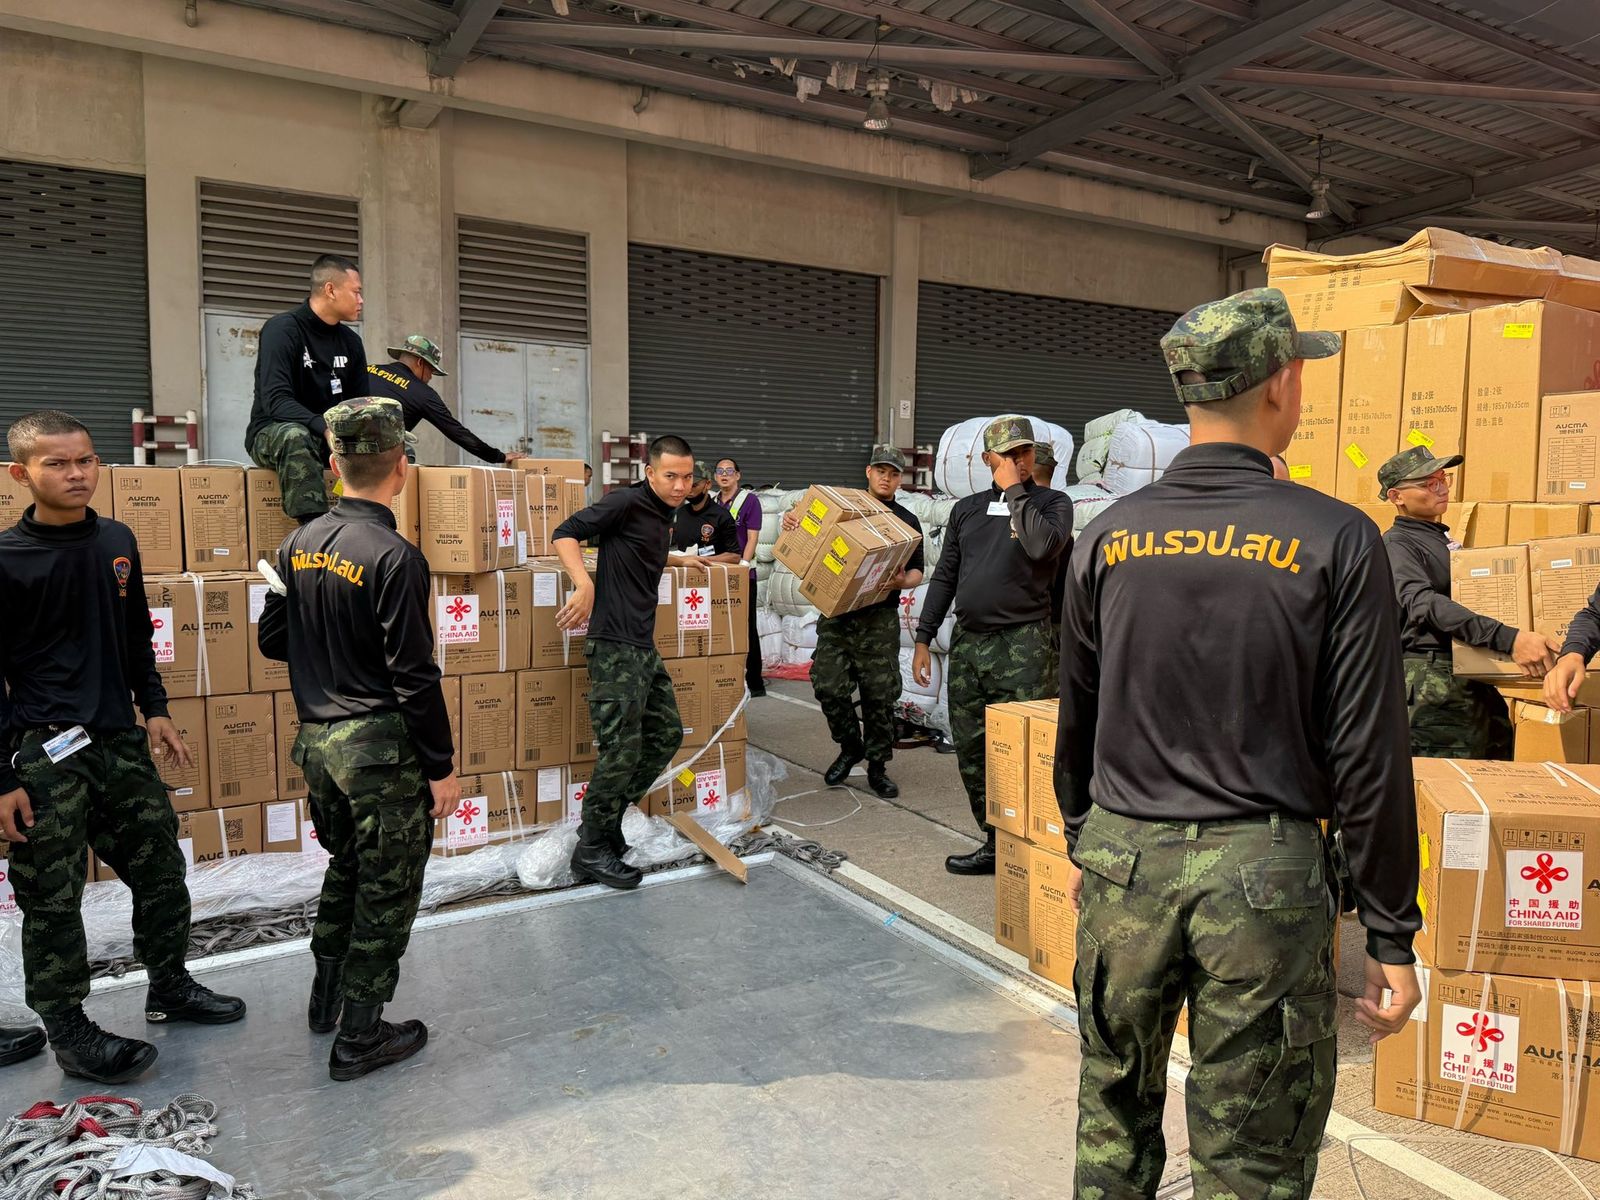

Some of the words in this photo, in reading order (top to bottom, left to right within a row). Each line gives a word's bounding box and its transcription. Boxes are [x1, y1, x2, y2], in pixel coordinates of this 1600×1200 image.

[1300, 418, 1335, 427] :185x70x35cm
[1103, 524, 1301, 574] พัน.รวป.สป.
[291, 549, 364, 587] พัน.รวป.สป.
[181, 622, 233, 631] AUCMA
[223, 721, 257, 730] AUCMA
[992, 740, 1011, 750] AUCMA
[1037, 752, 1055, 761] AUCM
[197, 849, 248, 862] AUCMA
[1004, 861, 1028, 874] AUCMA
[1040, 884, 1067, 898] AUCMA
[1509, 898, 1579, 910] 中国援助
[1508, 909, 1551, 920] CHINA
[1556, 911, 1580, 921] AID
[1524, 920, 1551, 928] SHARED
[1552, 921, 1580, 929] FUTURE
[1443, 1071, 1457, 1080] FOR
[1458, 1074, 1485, 1086] SHRED
[1486, 1079, 1514, 1092] FUTURE
[1490, 1070, 1515, 1084] AID
